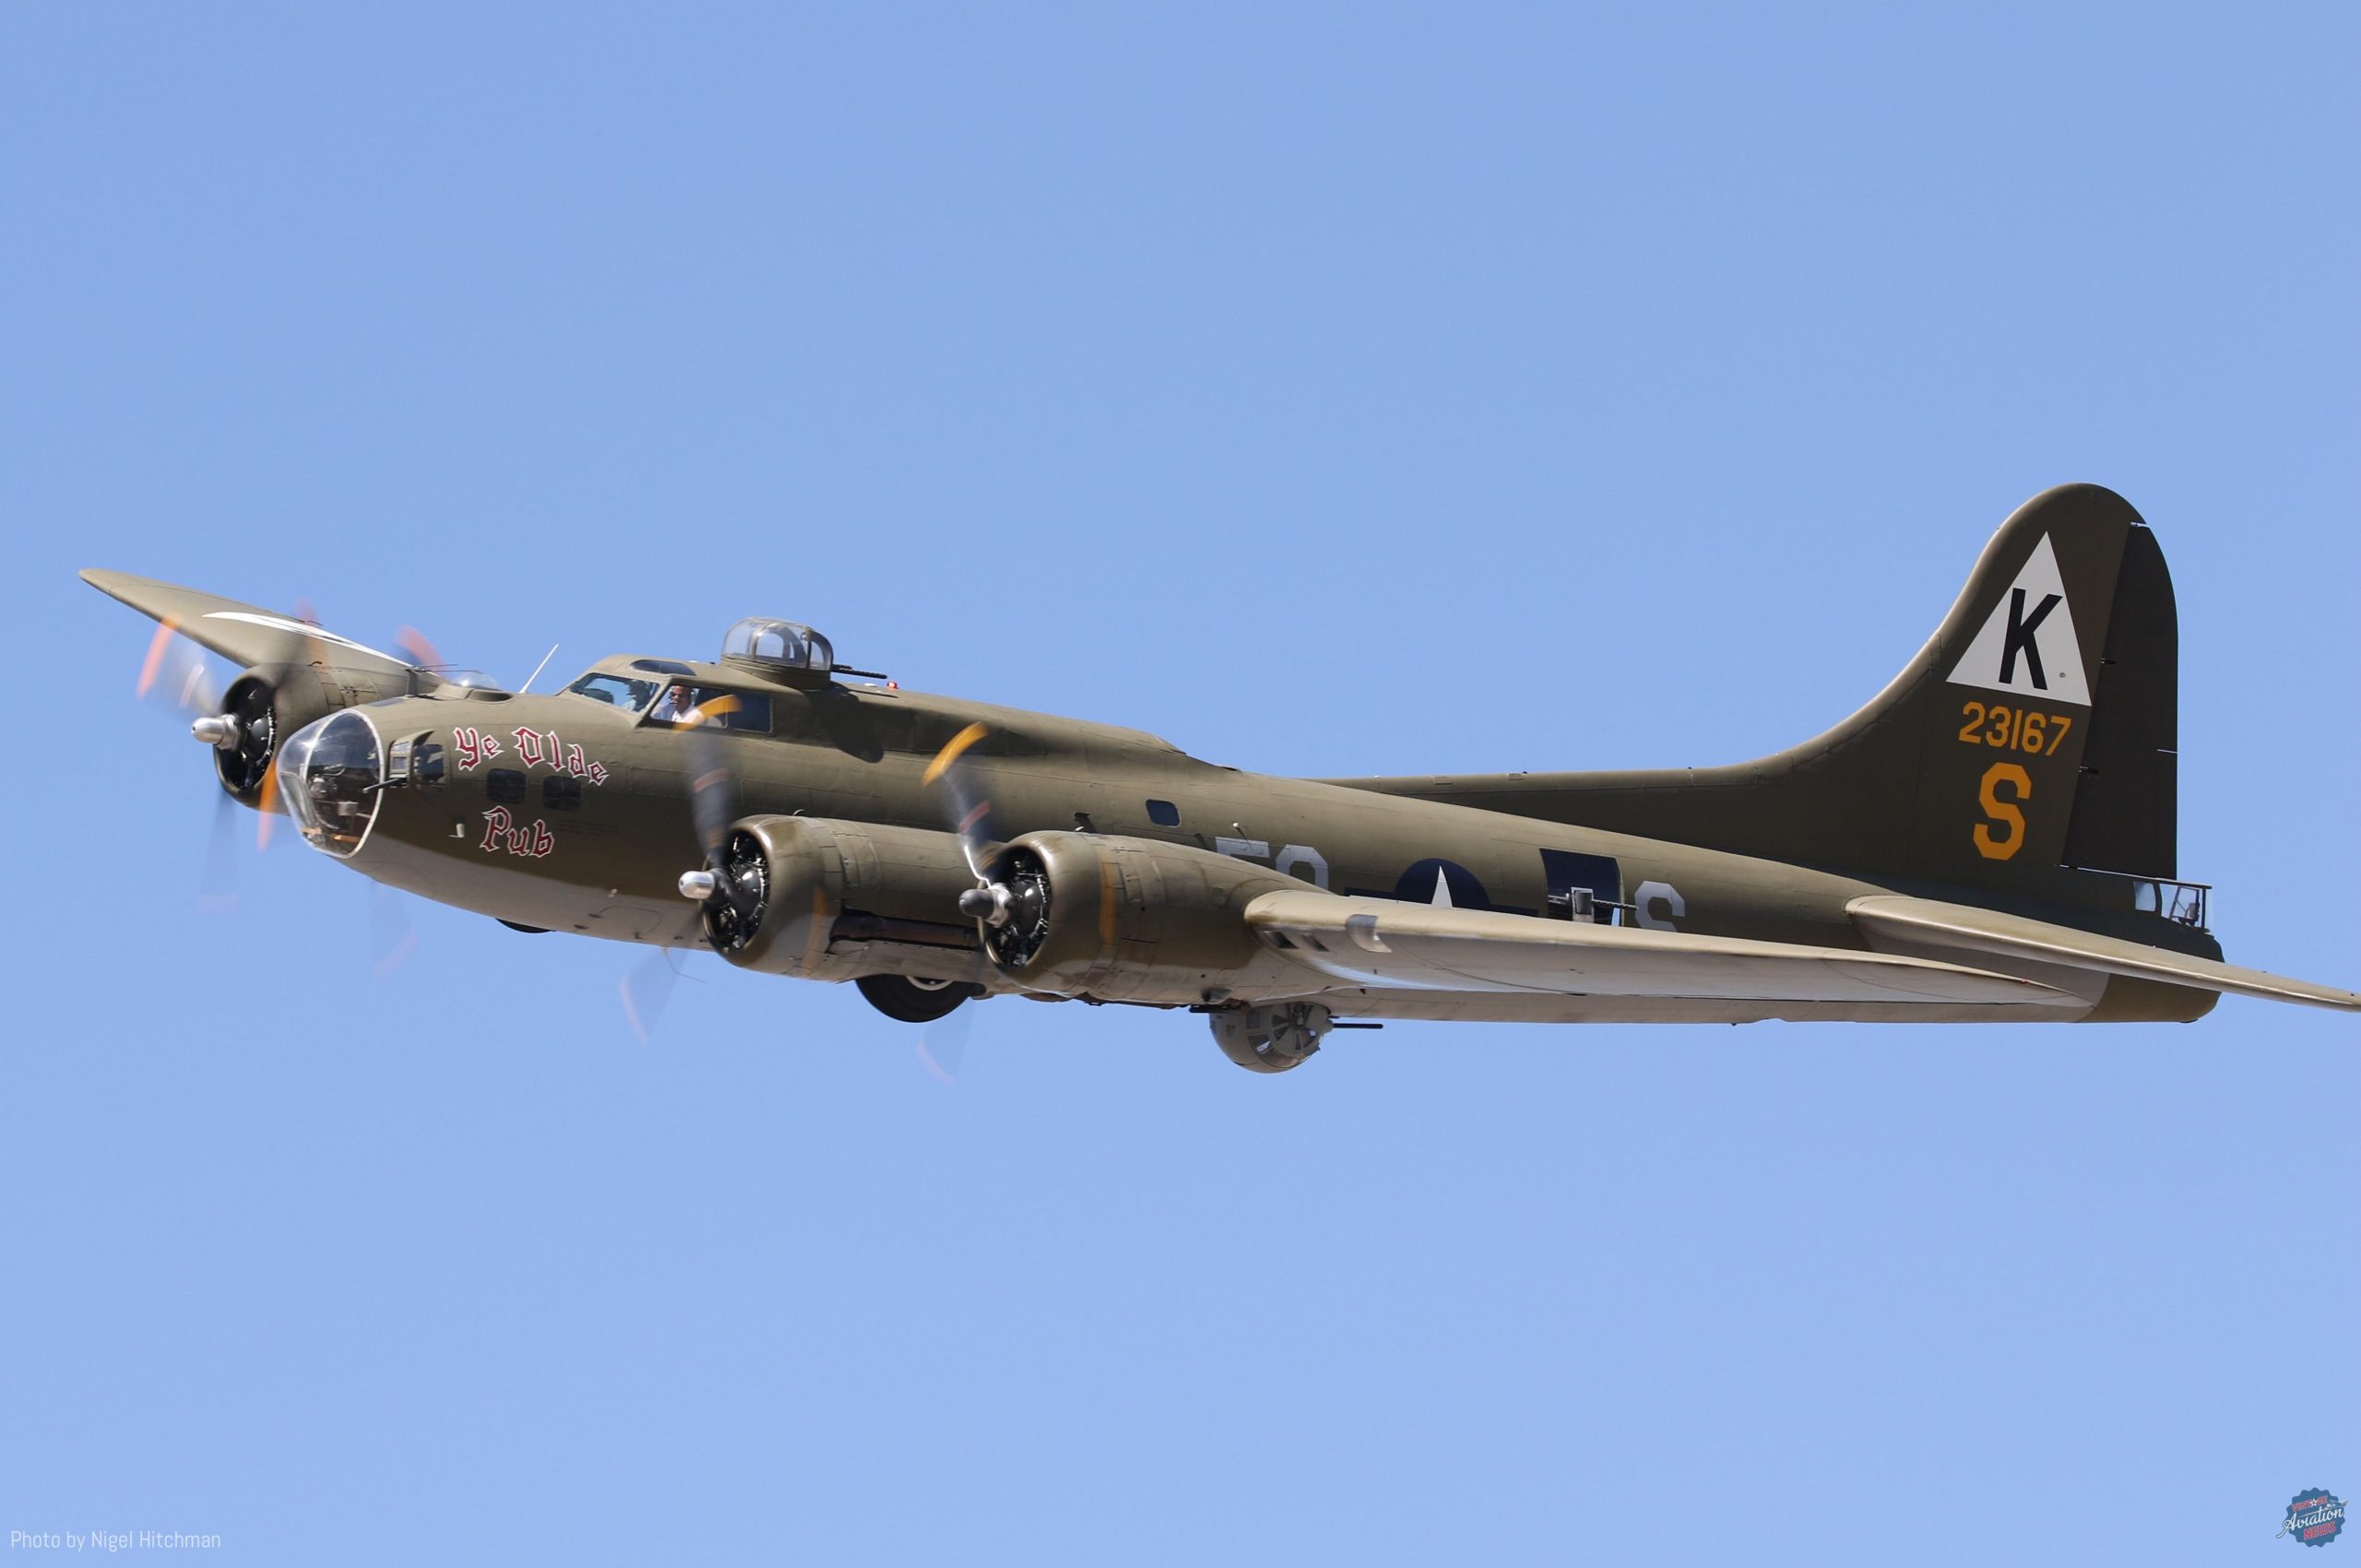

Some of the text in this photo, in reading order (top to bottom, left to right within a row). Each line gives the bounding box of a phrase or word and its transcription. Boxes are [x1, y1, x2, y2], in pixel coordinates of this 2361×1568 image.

[1998, 587, 2063, 691] K
[452, 726, 610, 786] Ye Olde
[1958, 701, 2072, 757] 23167
[479, 805, 555, 859] Pub
[1973, 761, 2033, 861] S
